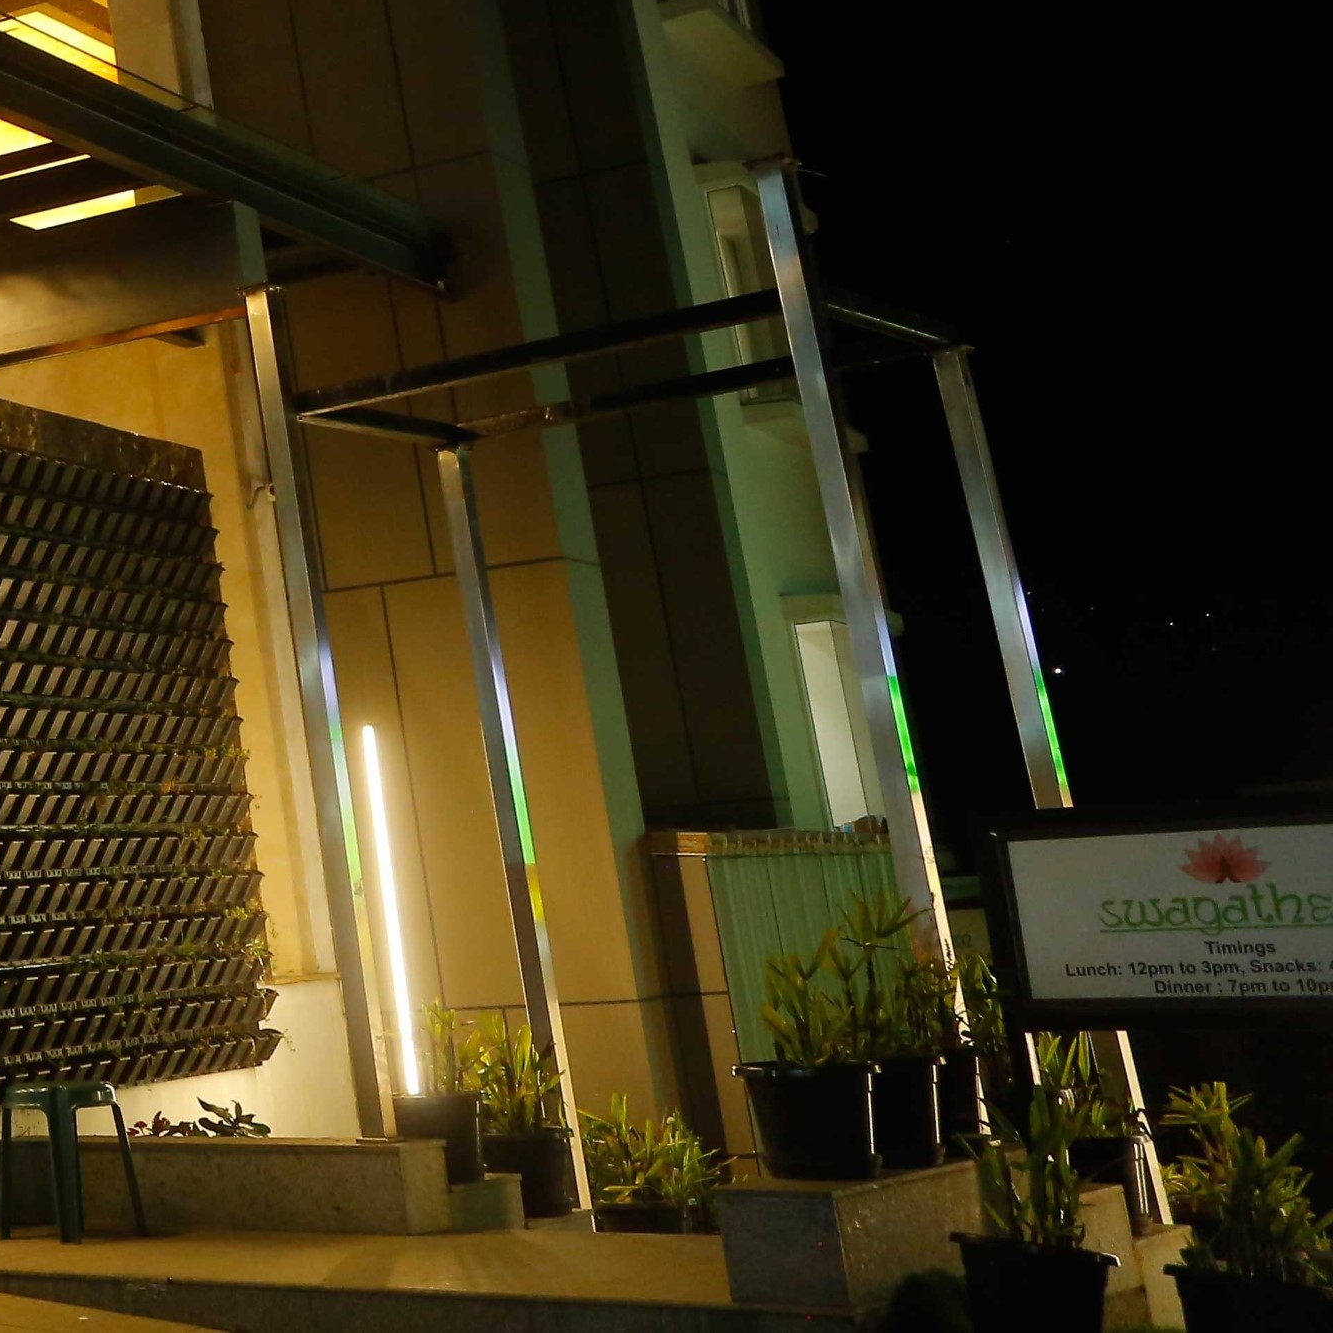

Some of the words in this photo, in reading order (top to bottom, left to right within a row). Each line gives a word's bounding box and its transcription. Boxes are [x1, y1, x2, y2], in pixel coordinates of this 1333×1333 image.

[1205, 940, 1276, 958] Timings
[1065, 963, 1123, 977] Lunch:
[1129, 961, 1174, 978] 12pm
[1179, 961, 1196, 974] to
[1201, 960, 1245, 977] 3pm,
[1154, 979, 1211, 994] Dinner
[1228, 978, 1268, 996] 7pm
[1272, 979, 1290, 992] to
[1297, 977, 1333, 995] 10p
